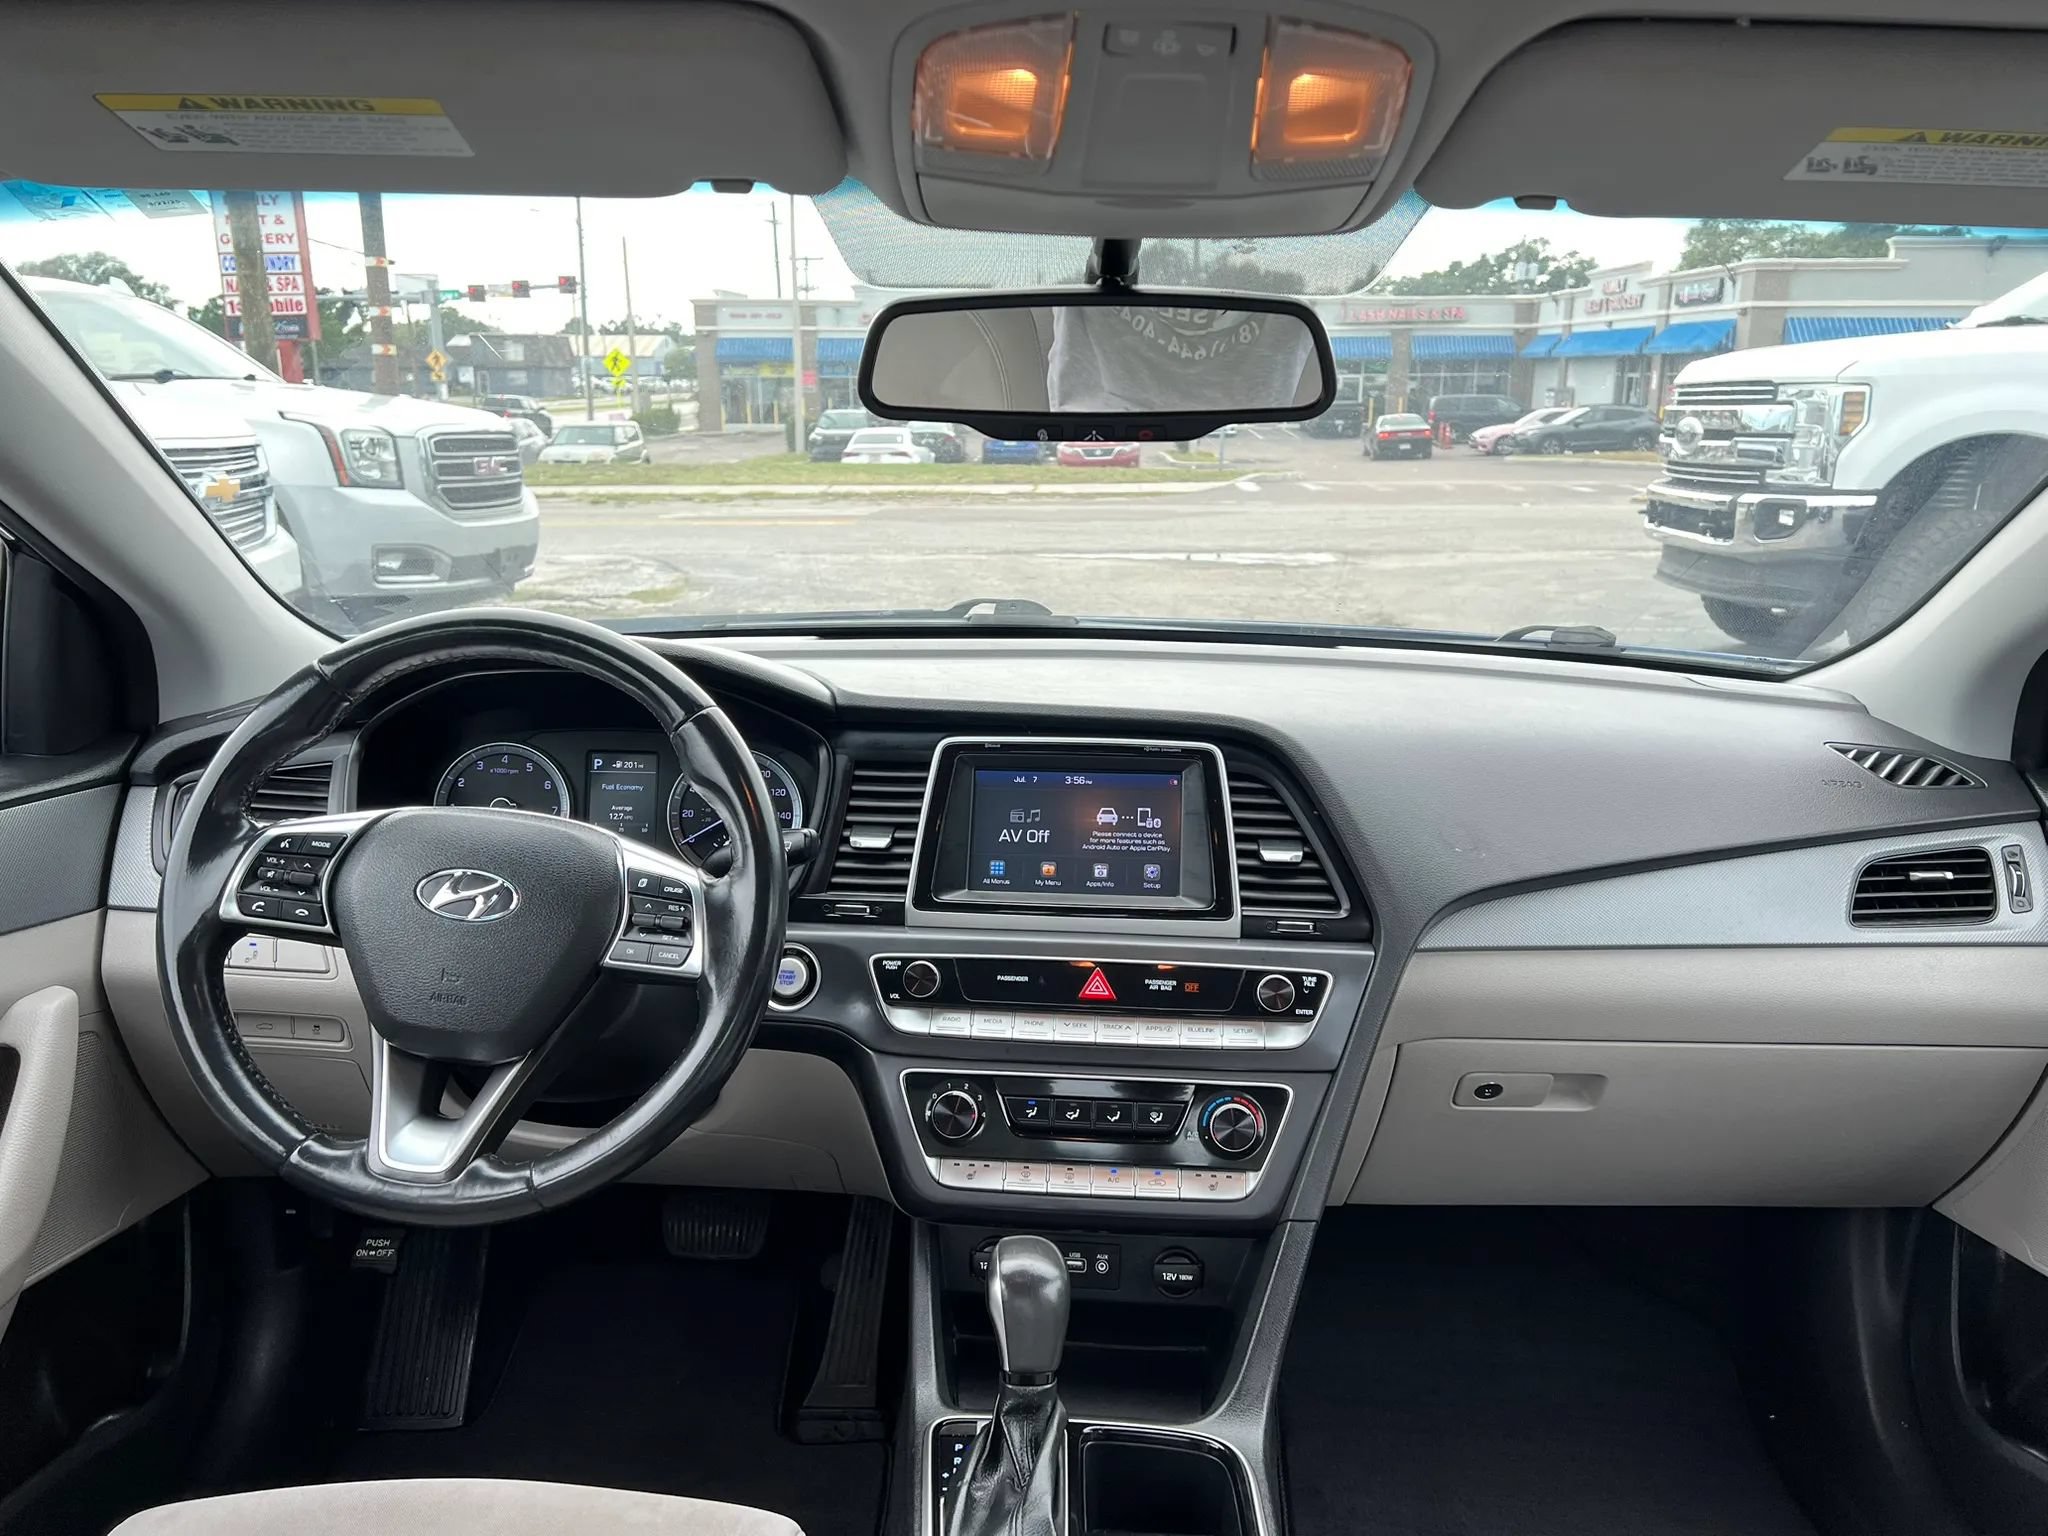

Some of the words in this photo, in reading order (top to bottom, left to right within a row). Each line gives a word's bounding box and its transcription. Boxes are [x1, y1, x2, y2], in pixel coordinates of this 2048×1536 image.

[210, 97, 375, 112] WARNING
[1939, 131, 2048, 146] WARNI
[220, 233, 295, 245] GERY
[277, 276, 300, 292] SPA
[501, 755, 508, 764] 4
[594, 758, 603, 770] P
[623, 761, 638, 769] 201
[476, 761, 484, 770] 3
[526, 763, 533, 772] 5
[458, 778, 465, 787] 2
[544, 780, 551, 790] 6
[1032, 776, 1038, 784] 7
[1065, 776, 1085, 785] 3:56
[616, 784, 644, 792] Economy
[770, 788, 786, 797] 120
[682, 809, 694, 818] 20
[998, 828, 1023, 843] AV
[1026, 828, 1050, 843] Off
[311, 840, 332, 848] MODE
[1129, 844, 1146, 852] Apple
[1147, 845, 1171, 853] CarPlay
[266, 856, 278, 864] VOL
[664, 886, 684, 894] CRUISE
[1143, 882, 1161, 890] Setup
[668, 904, 679, 912] RES
[658, 951, 680, 960] CANCEL
[996, 975, 1029, 983] PASSENGER
[1144, 978, 1177, 986] PASSENGER
[1160, 984, 1172, 992] BAG
[1184, 983, 1200, 992] OFF
[1295, 1008, 1314, 1016] ENTER
[964, 1082, 969, 1090] 2
[1108, 1176, 1120, 1184] A/C
[366, 1238, 391, 1247] PUSH
[356, 1249, 369, 1257] ON
[376, 1249, 395, 1257] OFF
[1162, 1272, 1177, 1281] 12V
[954, 1443, 964, 1452] P
[953, 1456, 962, 1465] R
